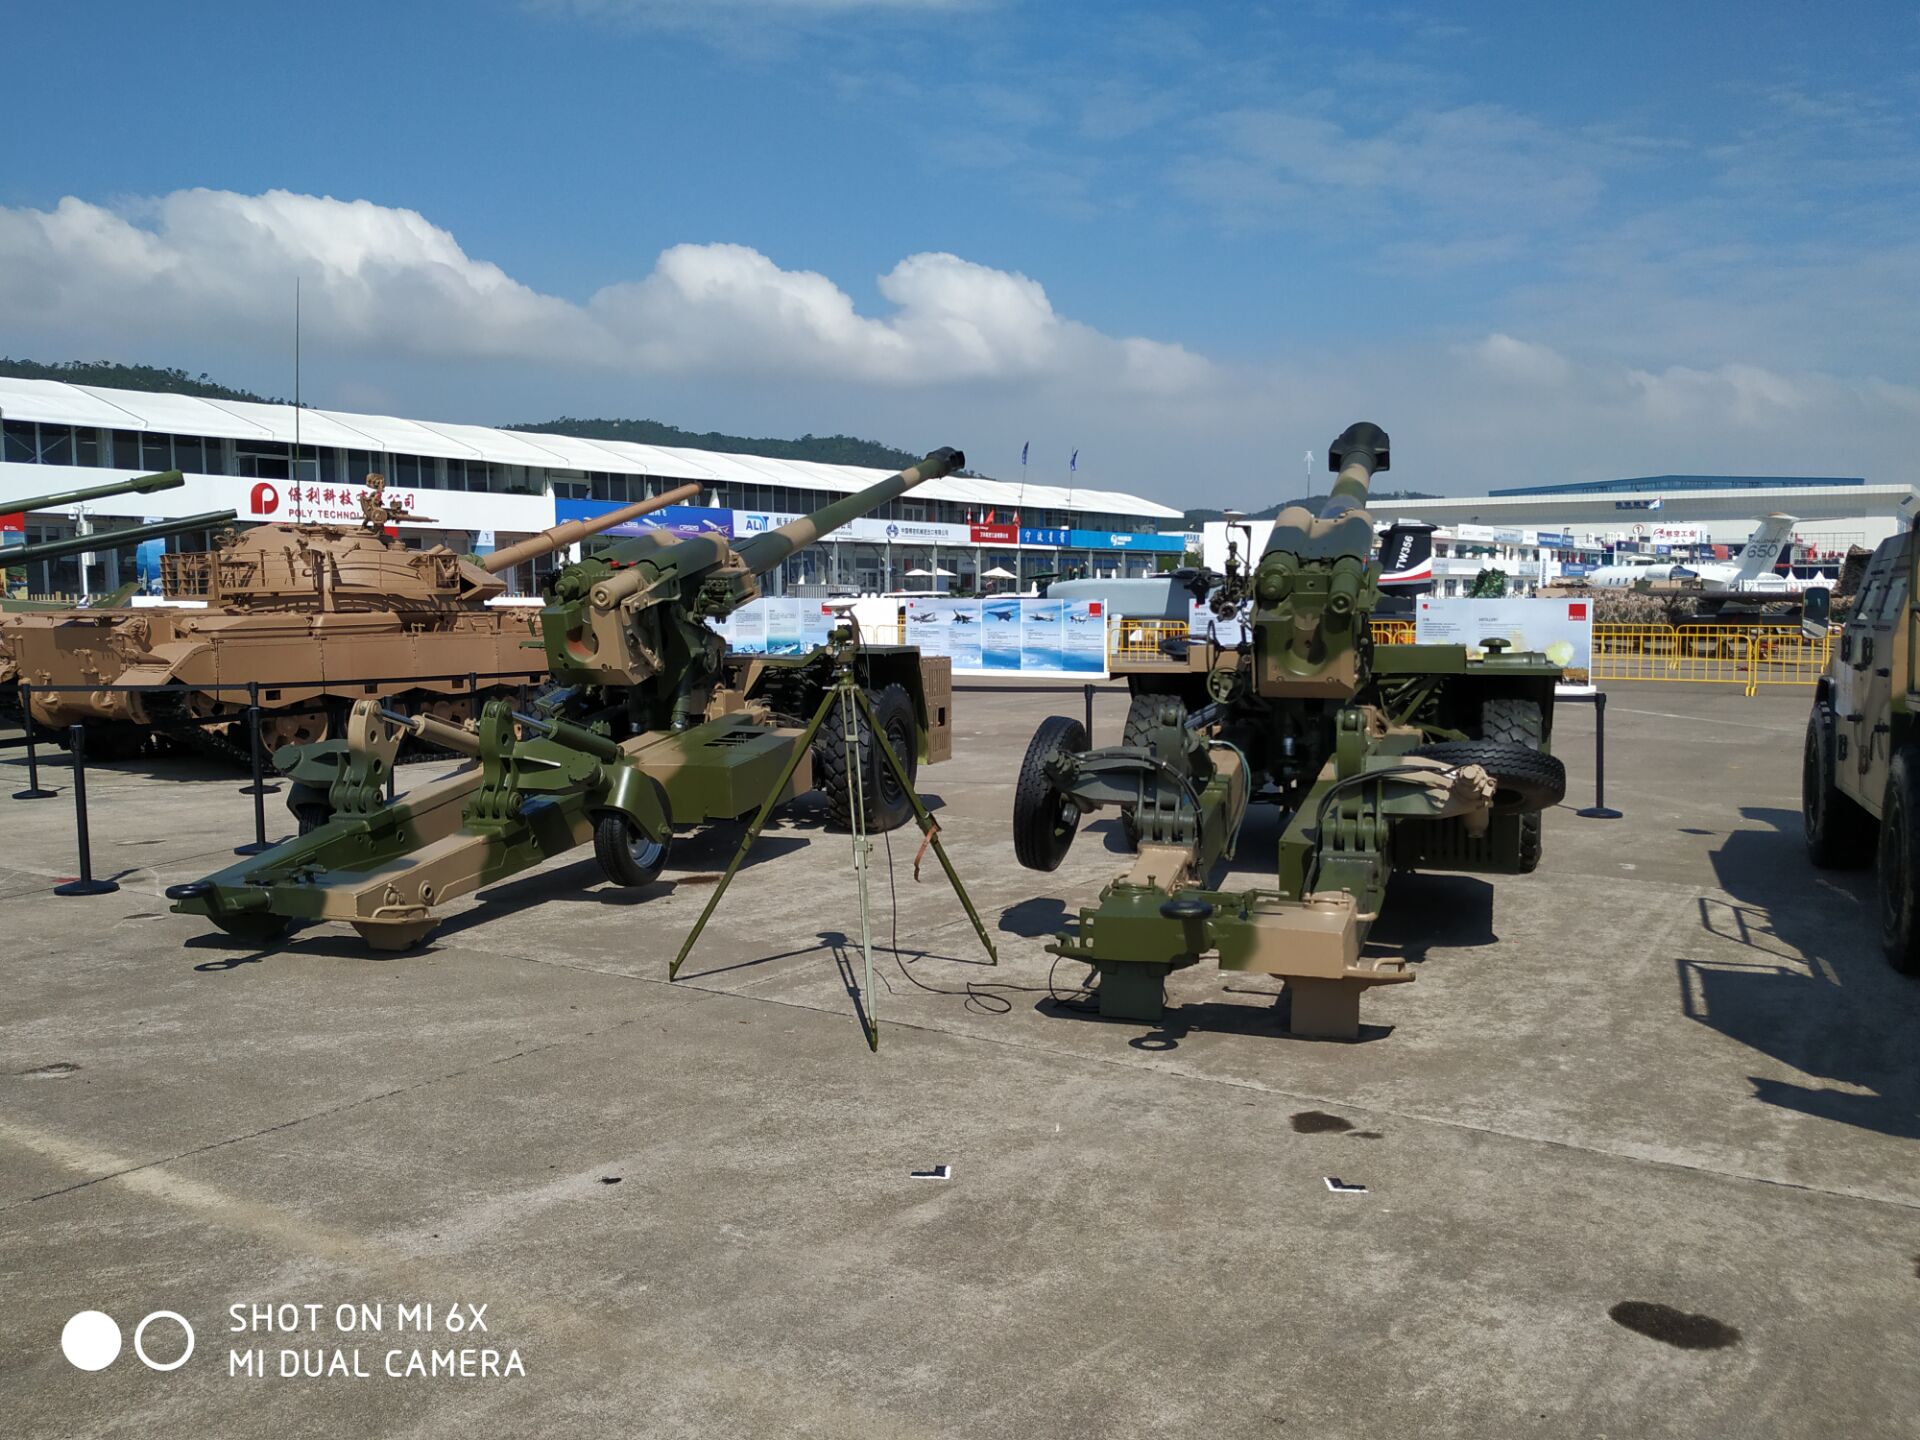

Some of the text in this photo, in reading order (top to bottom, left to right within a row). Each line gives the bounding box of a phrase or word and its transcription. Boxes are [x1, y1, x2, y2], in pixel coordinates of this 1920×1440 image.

[289, 508, 313, 518] POLY
[1395, 535, 1414, 569] TW356
[1747, 543, 1778, 558] 650
